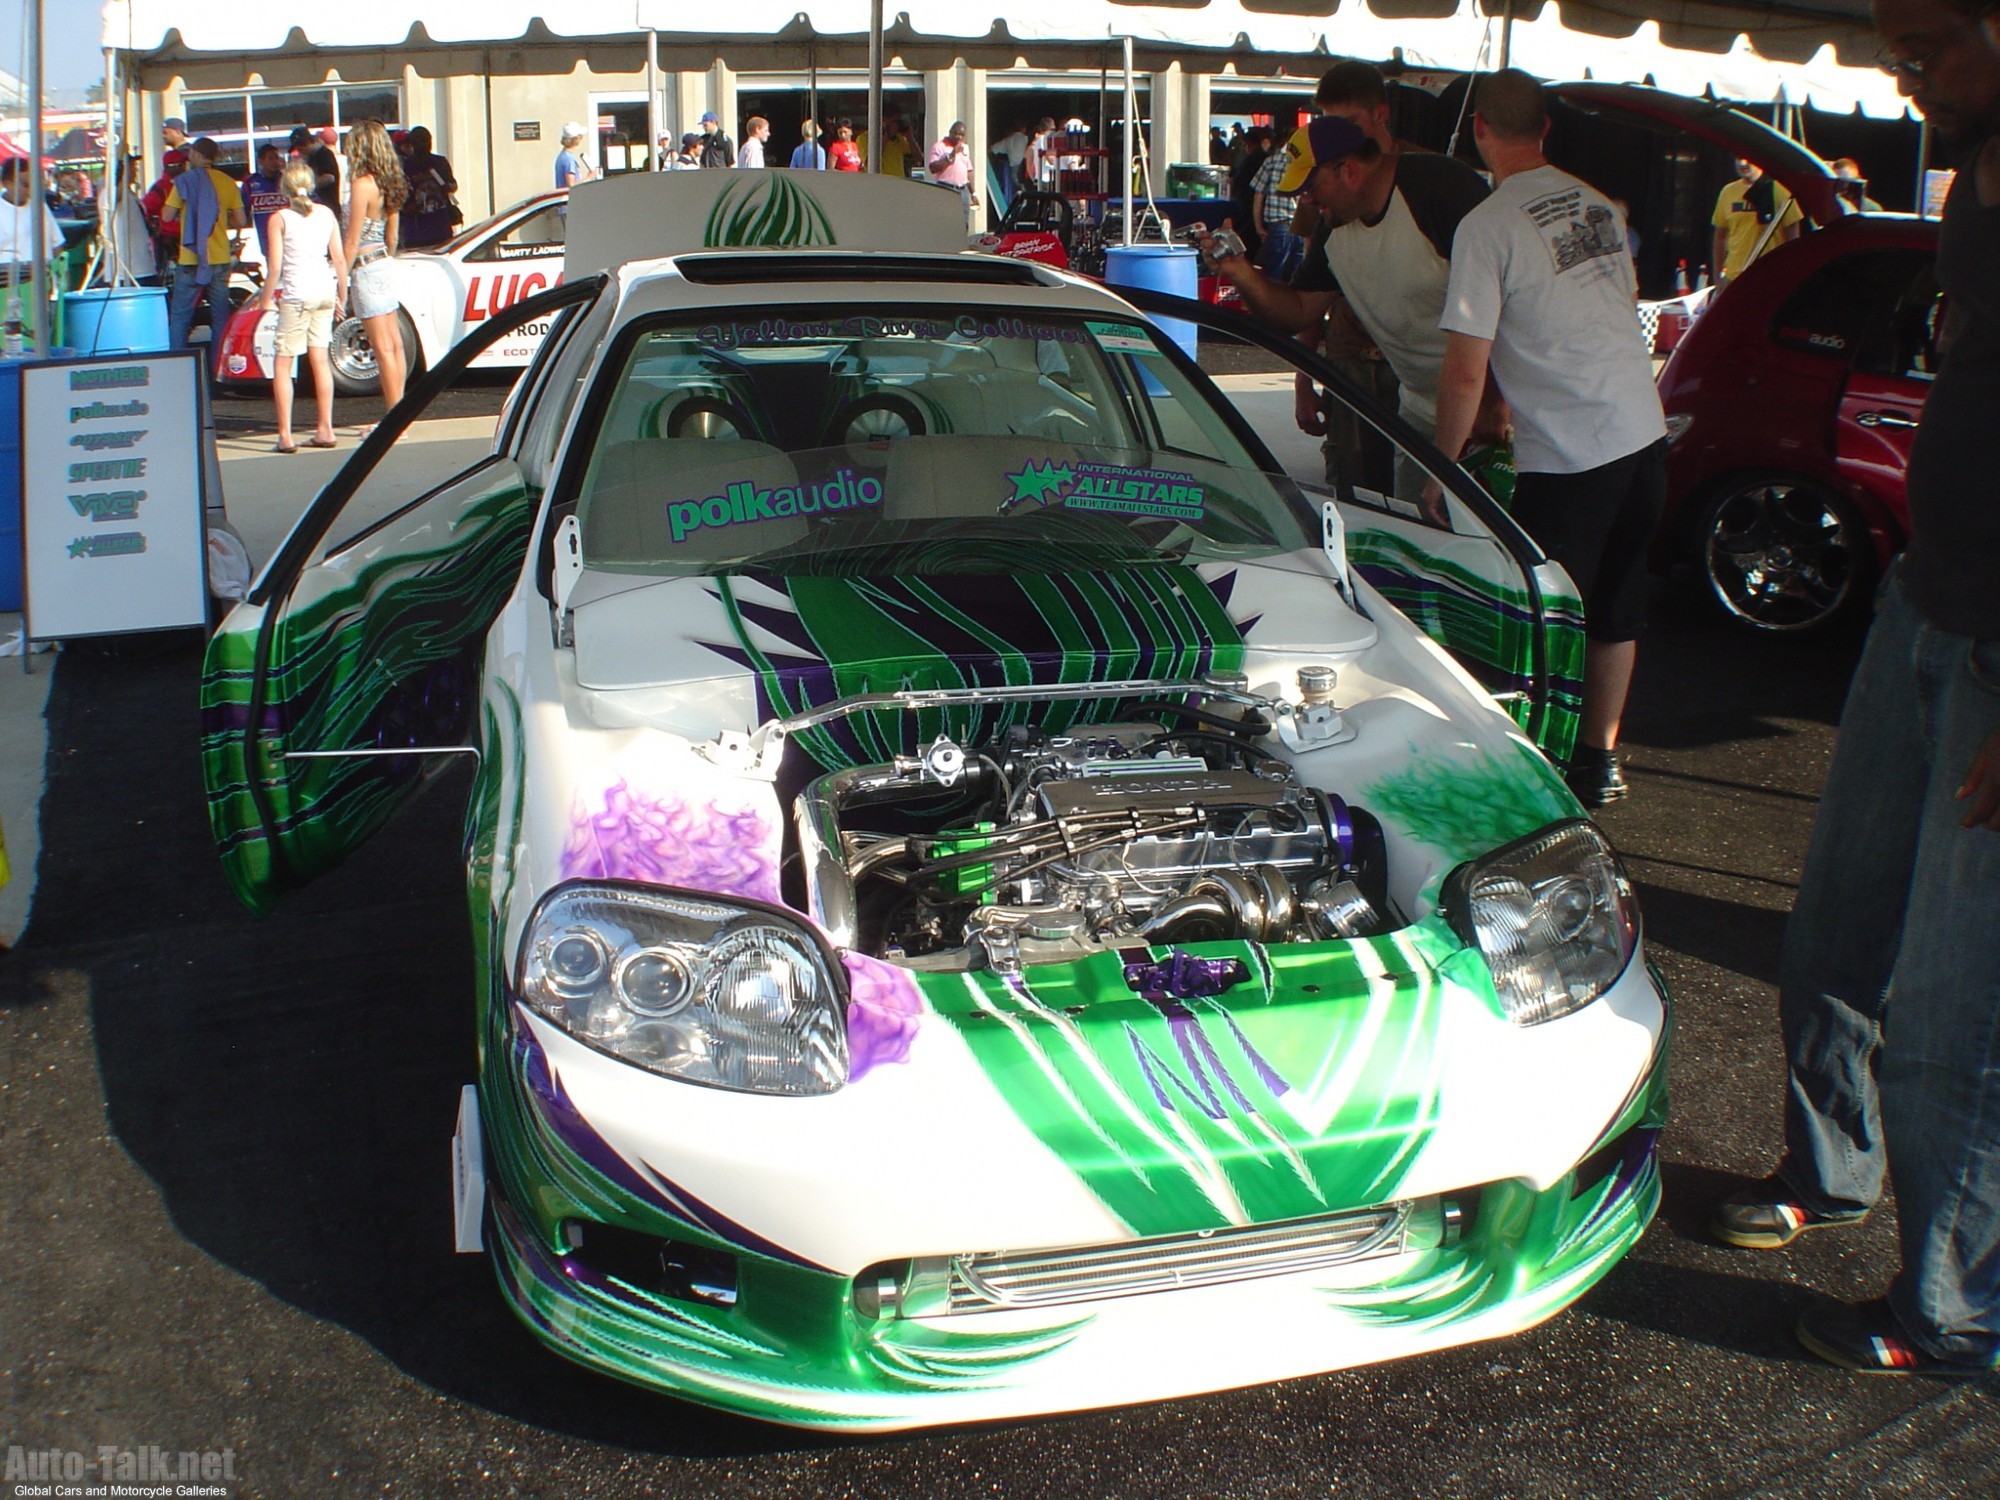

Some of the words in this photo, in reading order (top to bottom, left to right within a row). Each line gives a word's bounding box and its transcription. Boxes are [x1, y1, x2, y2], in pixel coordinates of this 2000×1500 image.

[697, 318, 835, 351] Yellow
[842, 314, 940, 339] River
[951, 314, 1093, 345] Collision
[1077, 463, 1195, 482] INTERNATIONAL
[1073, 476, 1204, 506] ALLSTARS
[667, 468, 884, 542] polkaudio
[1069, 496, 1197, 518] WWW.TEAMALLSTARS.COM
[1091, 779, 1232, 796] HONDA
